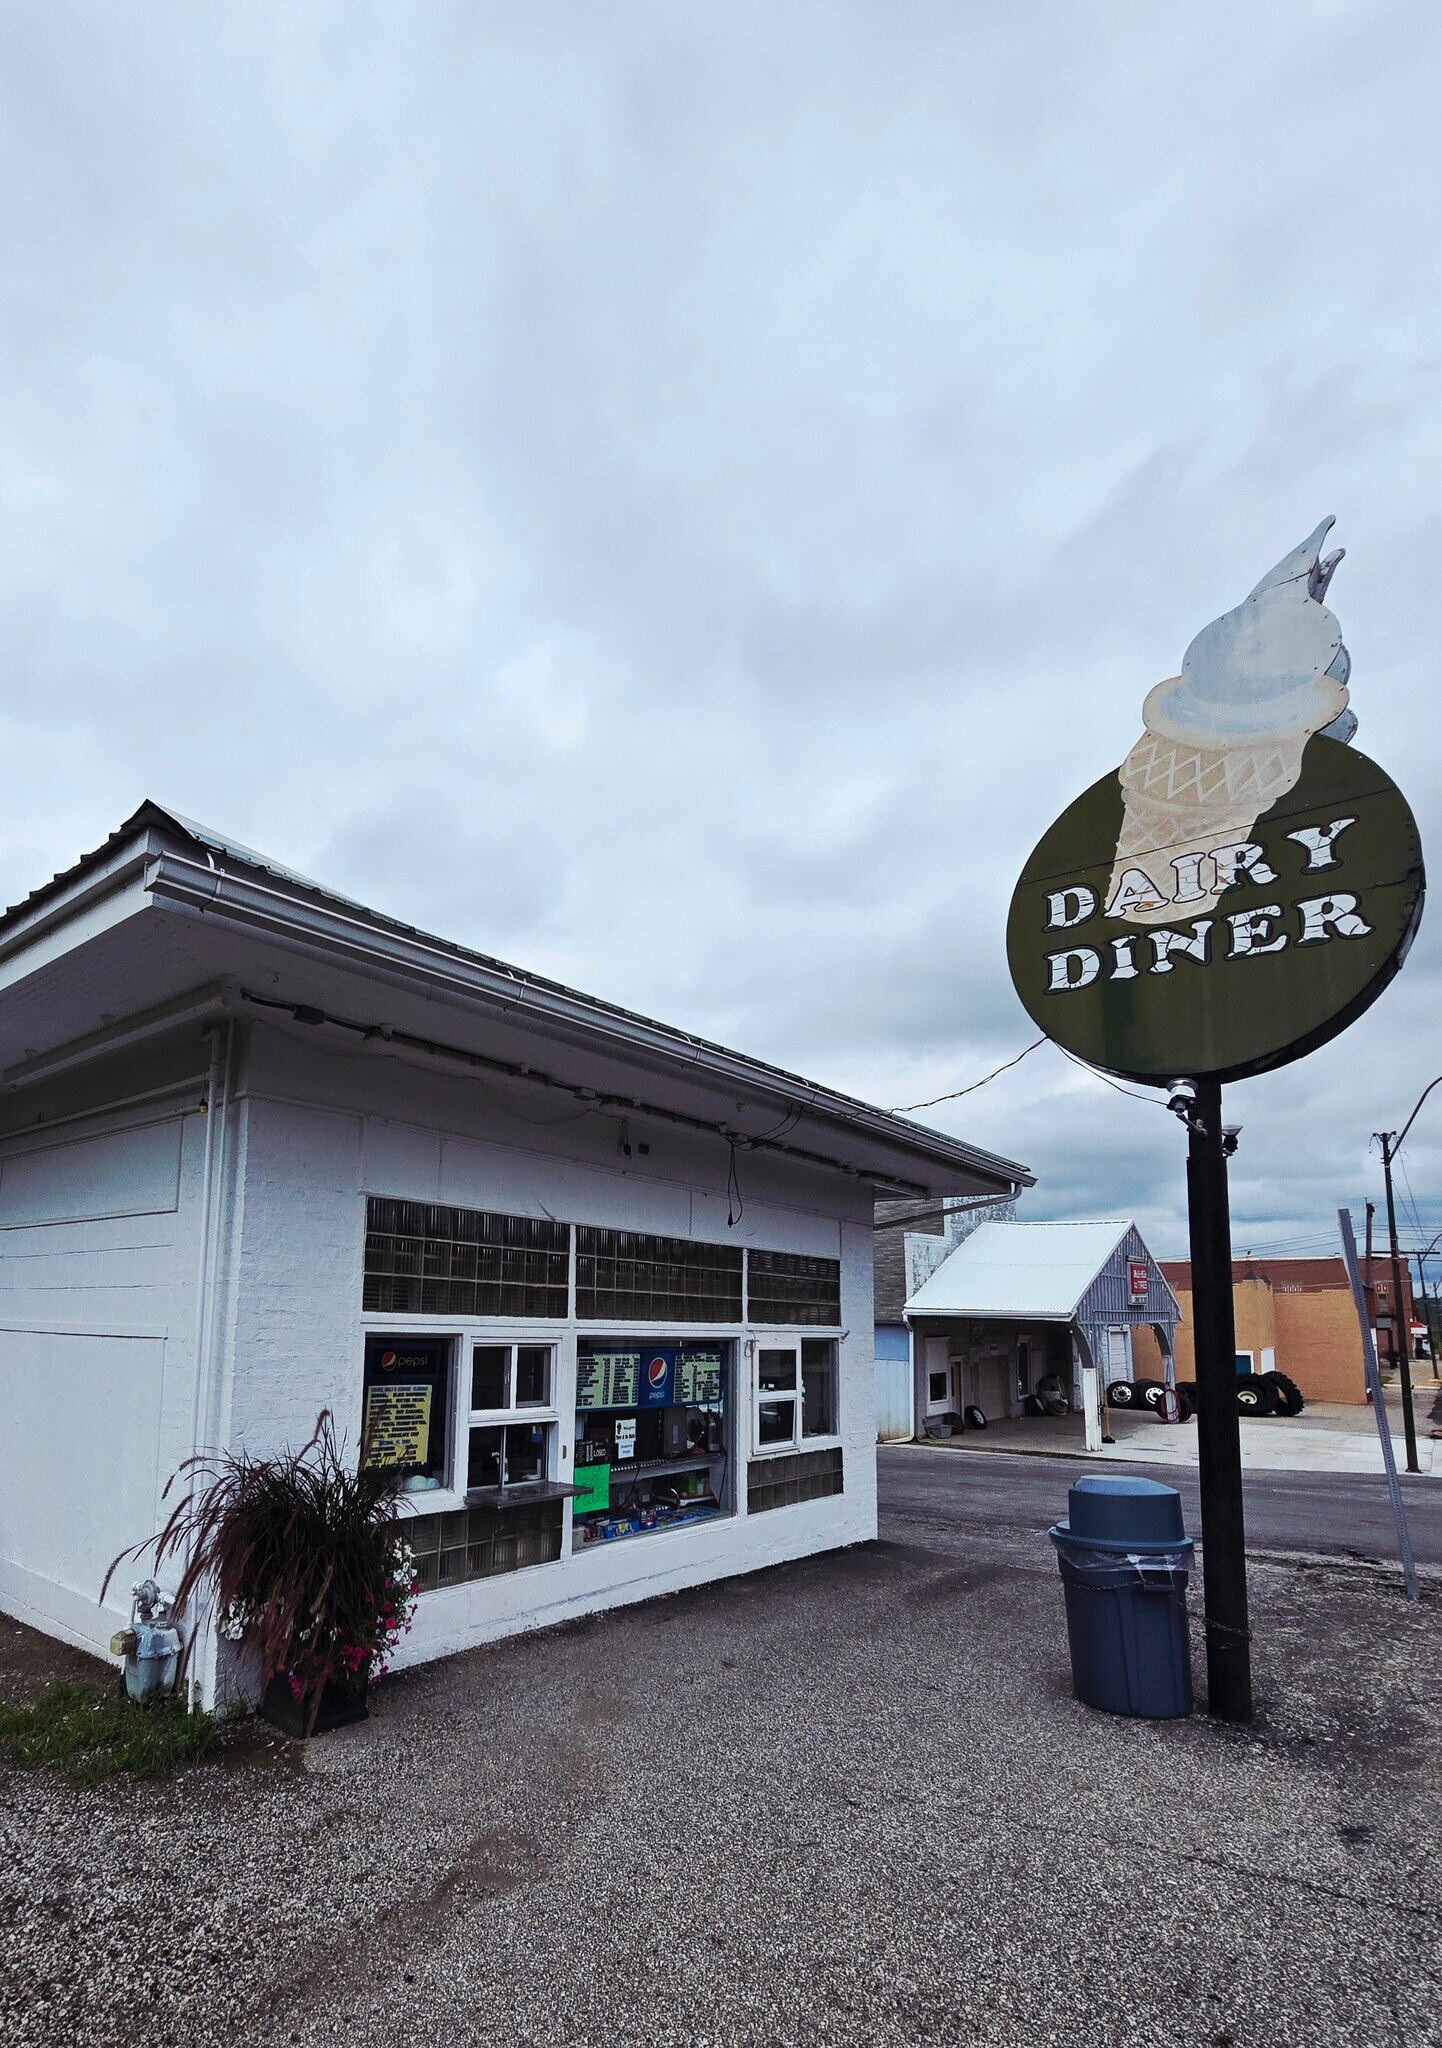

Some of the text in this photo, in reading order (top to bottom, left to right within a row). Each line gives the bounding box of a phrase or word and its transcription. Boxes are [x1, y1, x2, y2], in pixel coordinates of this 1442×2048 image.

[1044, 816, 1360, 931] DAIRY
[1045, 890, 1375, 994] DINER
[398, 1355, 428, 1368] pepsi
[649, 1390, 665, 1400] pepsi
